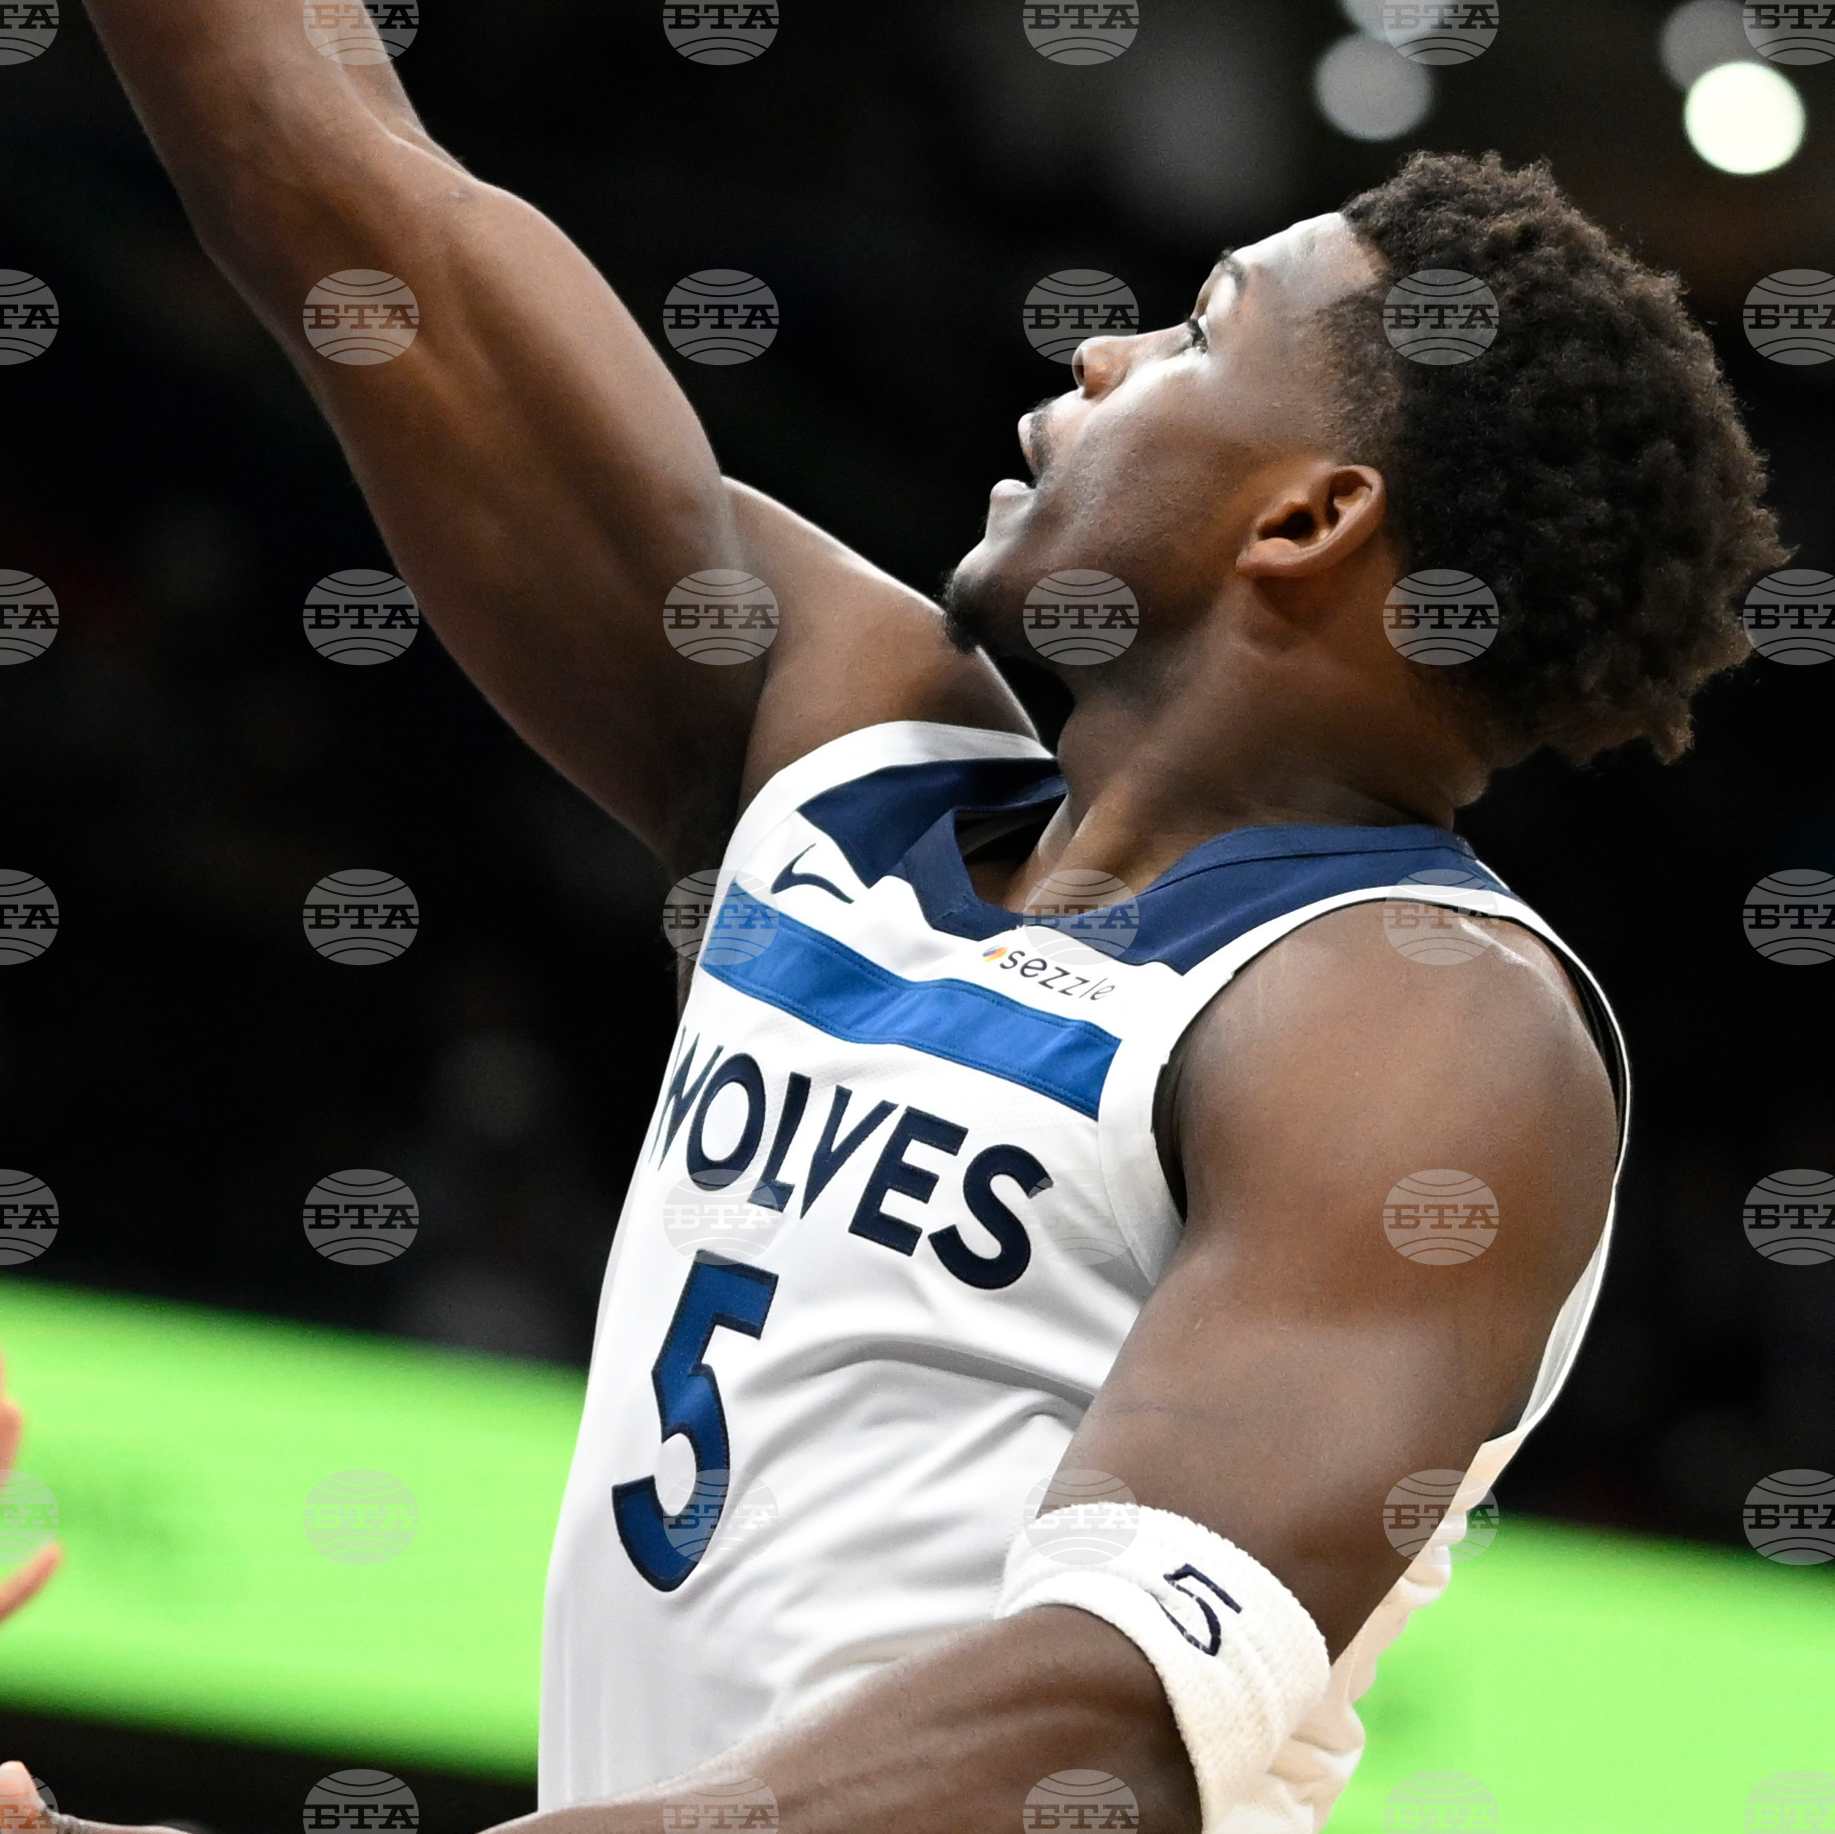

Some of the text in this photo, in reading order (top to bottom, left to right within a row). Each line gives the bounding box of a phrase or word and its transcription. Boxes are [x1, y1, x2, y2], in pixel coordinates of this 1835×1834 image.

[998, 948, 1117, 1002] sezzle
[647, 1023, 1054, 1291] WOLVES
[611, 1248, 779, 1594] 5
[1159, 1562, 1243, 1657] 5
